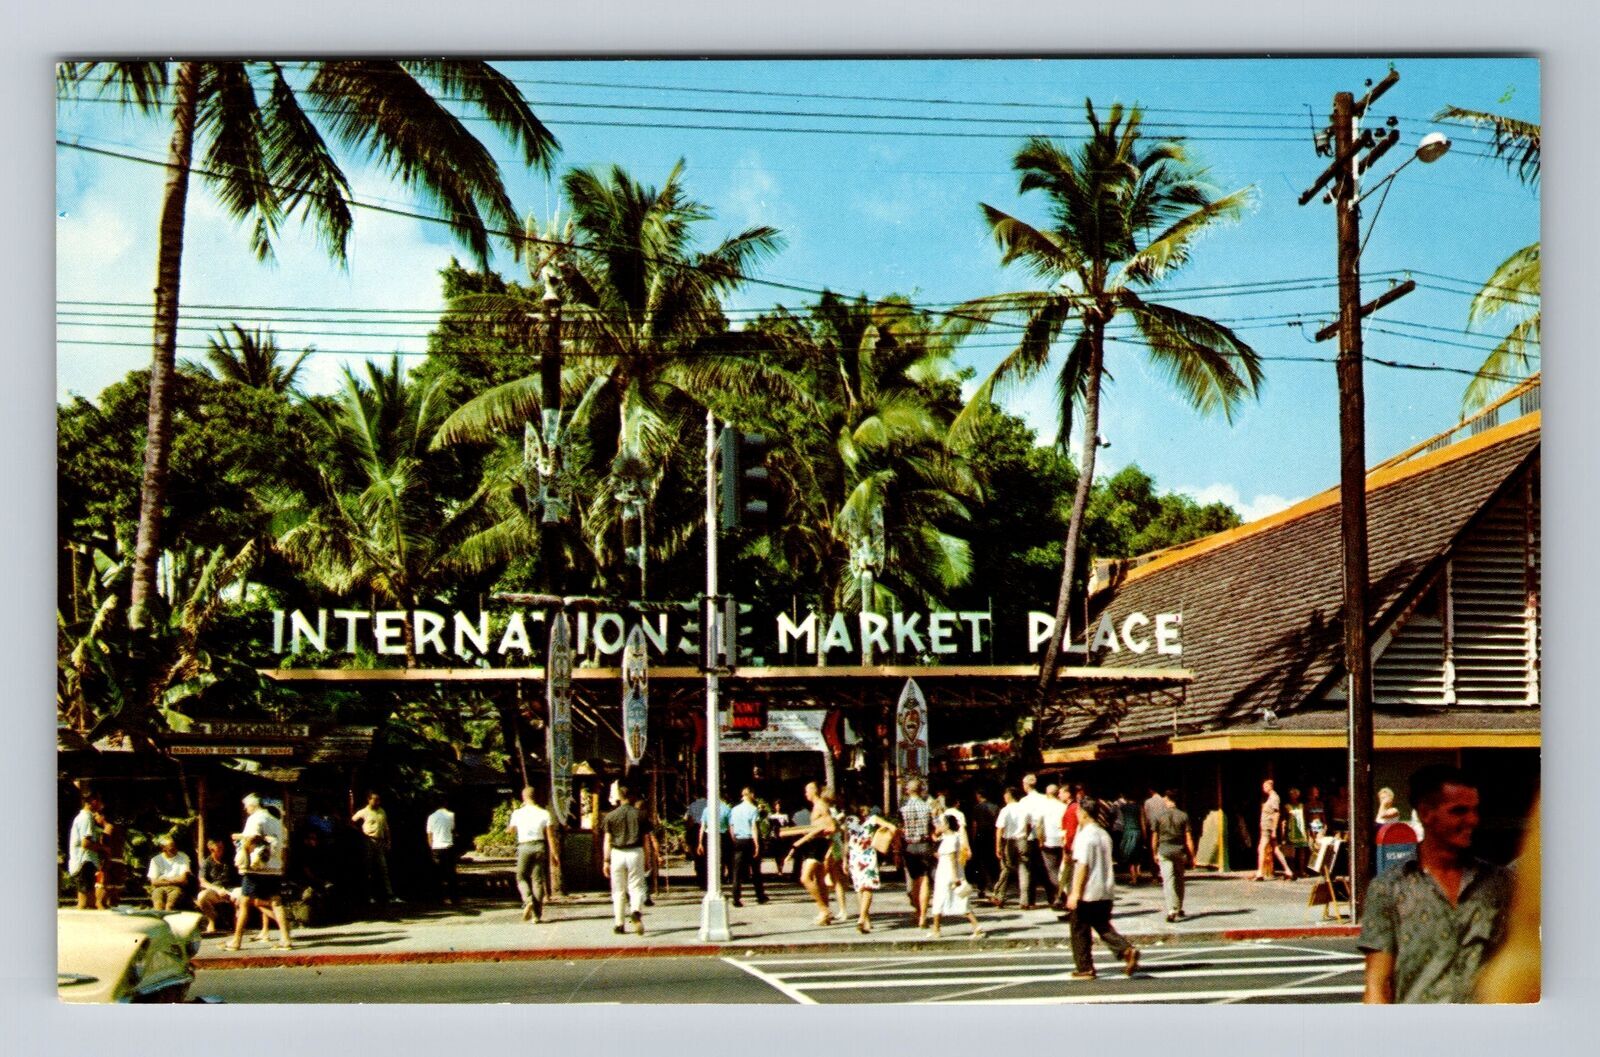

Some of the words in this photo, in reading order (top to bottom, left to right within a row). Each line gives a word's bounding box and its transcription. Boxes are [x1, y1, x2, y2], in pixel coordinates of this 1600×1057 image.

[776, 611, 992, 655] MARKET
[1028, 610, 1184, 655] PLACE
[733, 716, 761, 729] WALK
